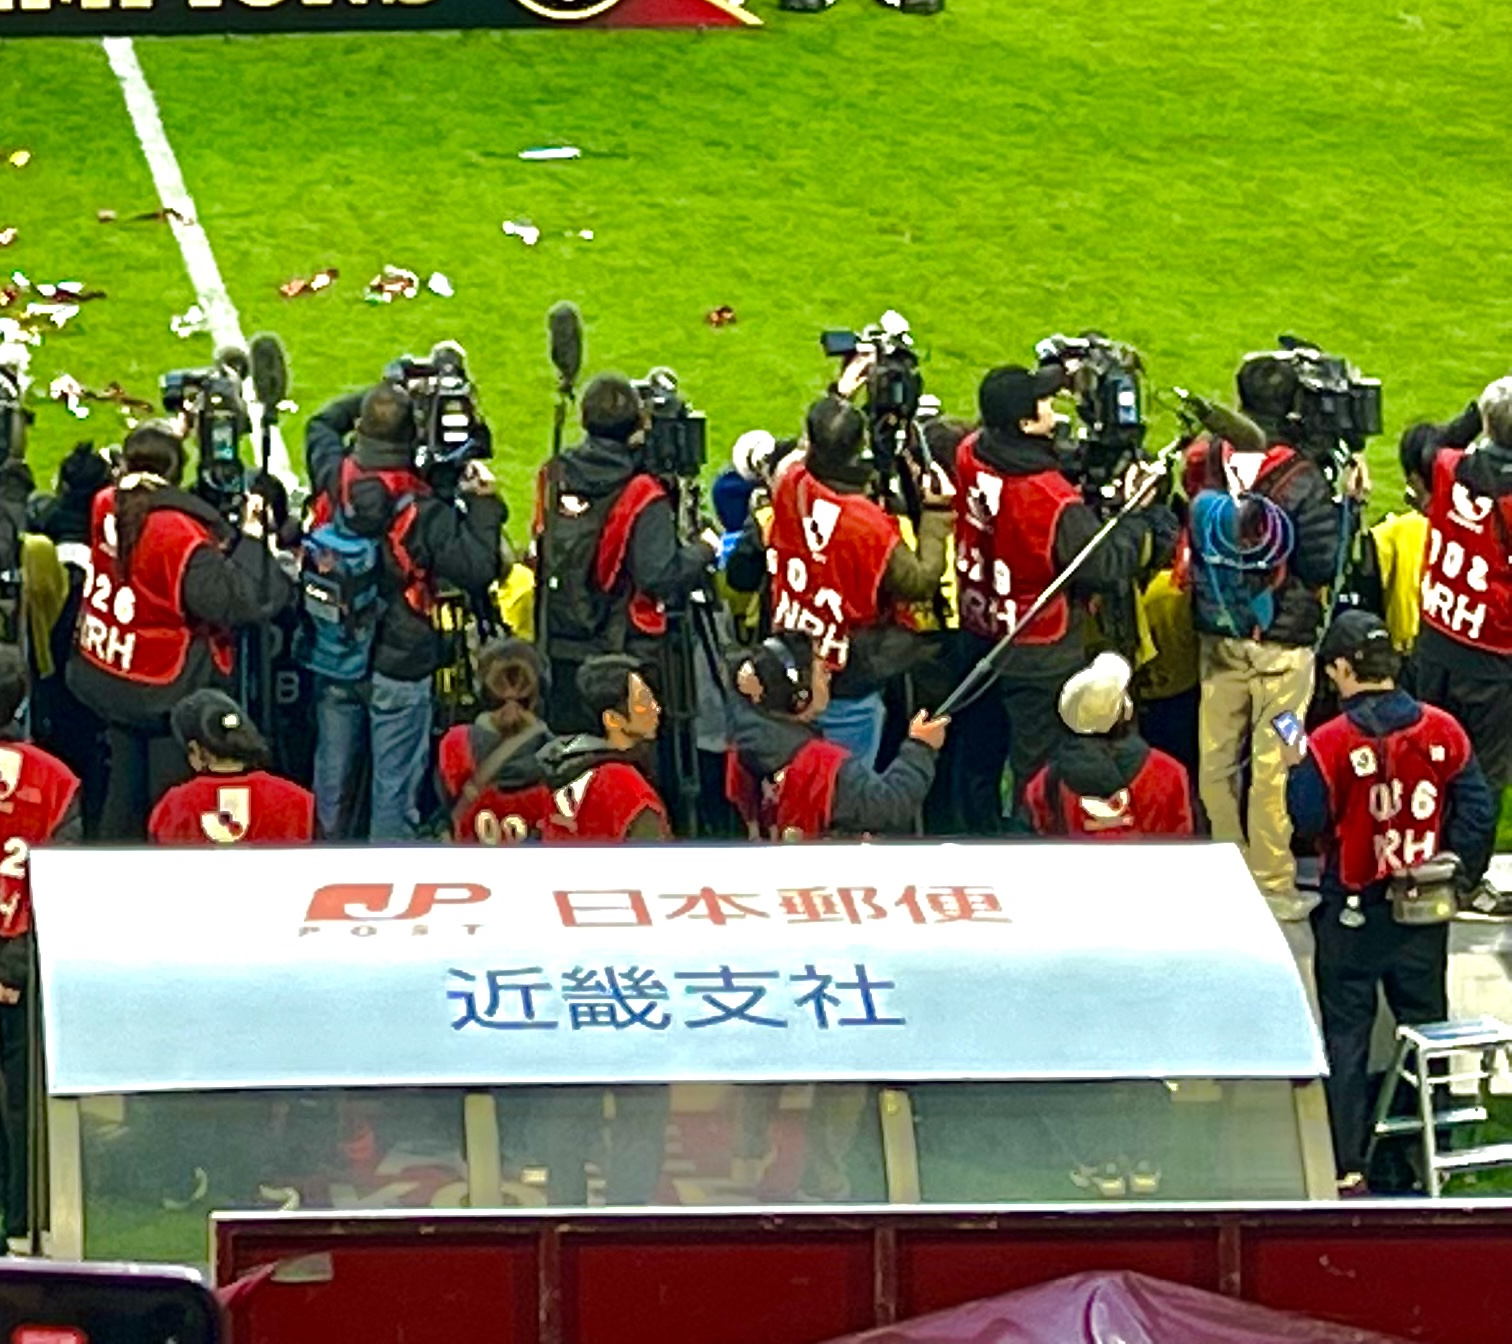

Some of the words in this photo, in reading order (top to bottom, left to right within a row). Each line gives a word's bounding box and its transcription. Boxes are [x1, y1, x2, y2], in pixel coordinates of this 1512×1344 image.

[552, 884, 1014, 928] 日本郵便
[297, 923, 485, 938] POST
[445, 963, 907, 1032] 近畿支社
